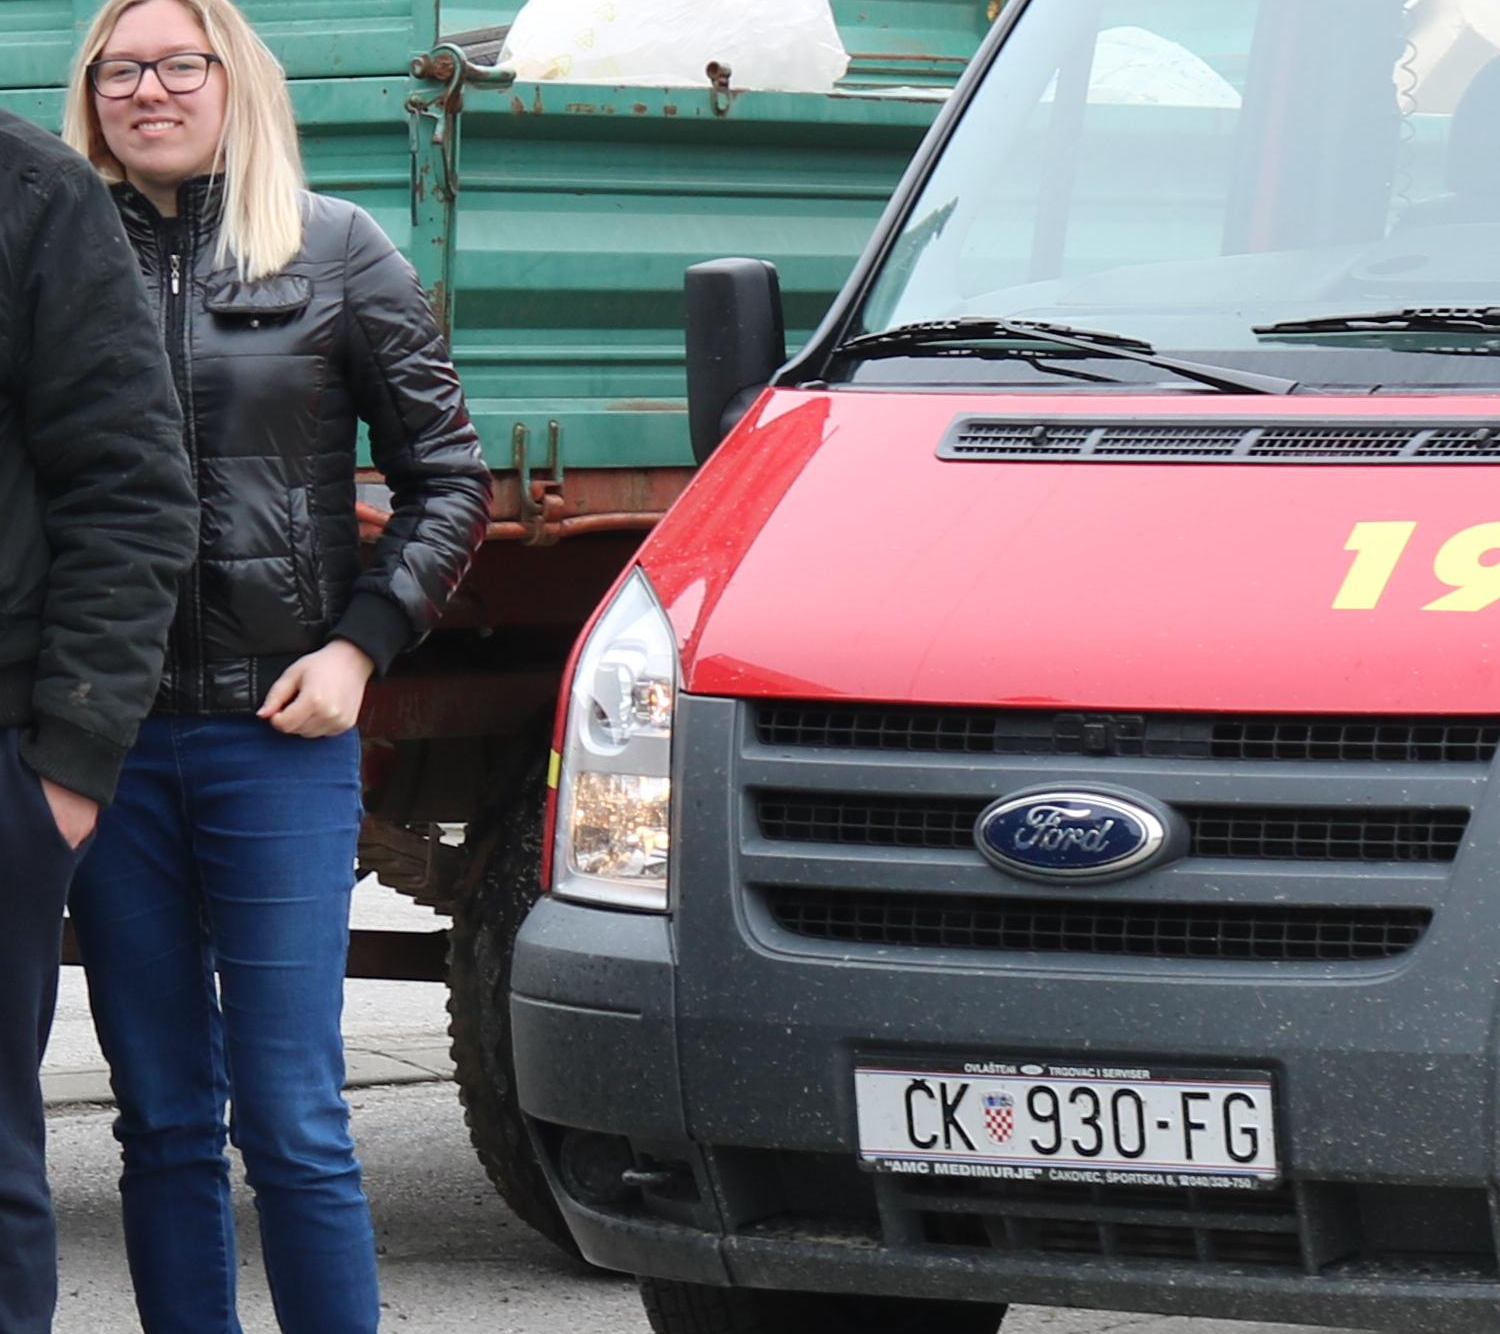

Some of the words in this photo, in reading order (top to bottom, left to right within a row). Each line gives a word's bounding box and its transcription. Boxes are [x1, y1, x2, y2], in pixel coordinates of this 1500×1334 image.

[1014, 805, 1114, 852] Ford
[1049, 1066, 1096, 1078] TRGOVAC
[1102, 1069, 1150, 1080] SERVISER
[904, 1078, 978, 1151] ČK
[1027, 1084, 1259, 1164] 930-FG
